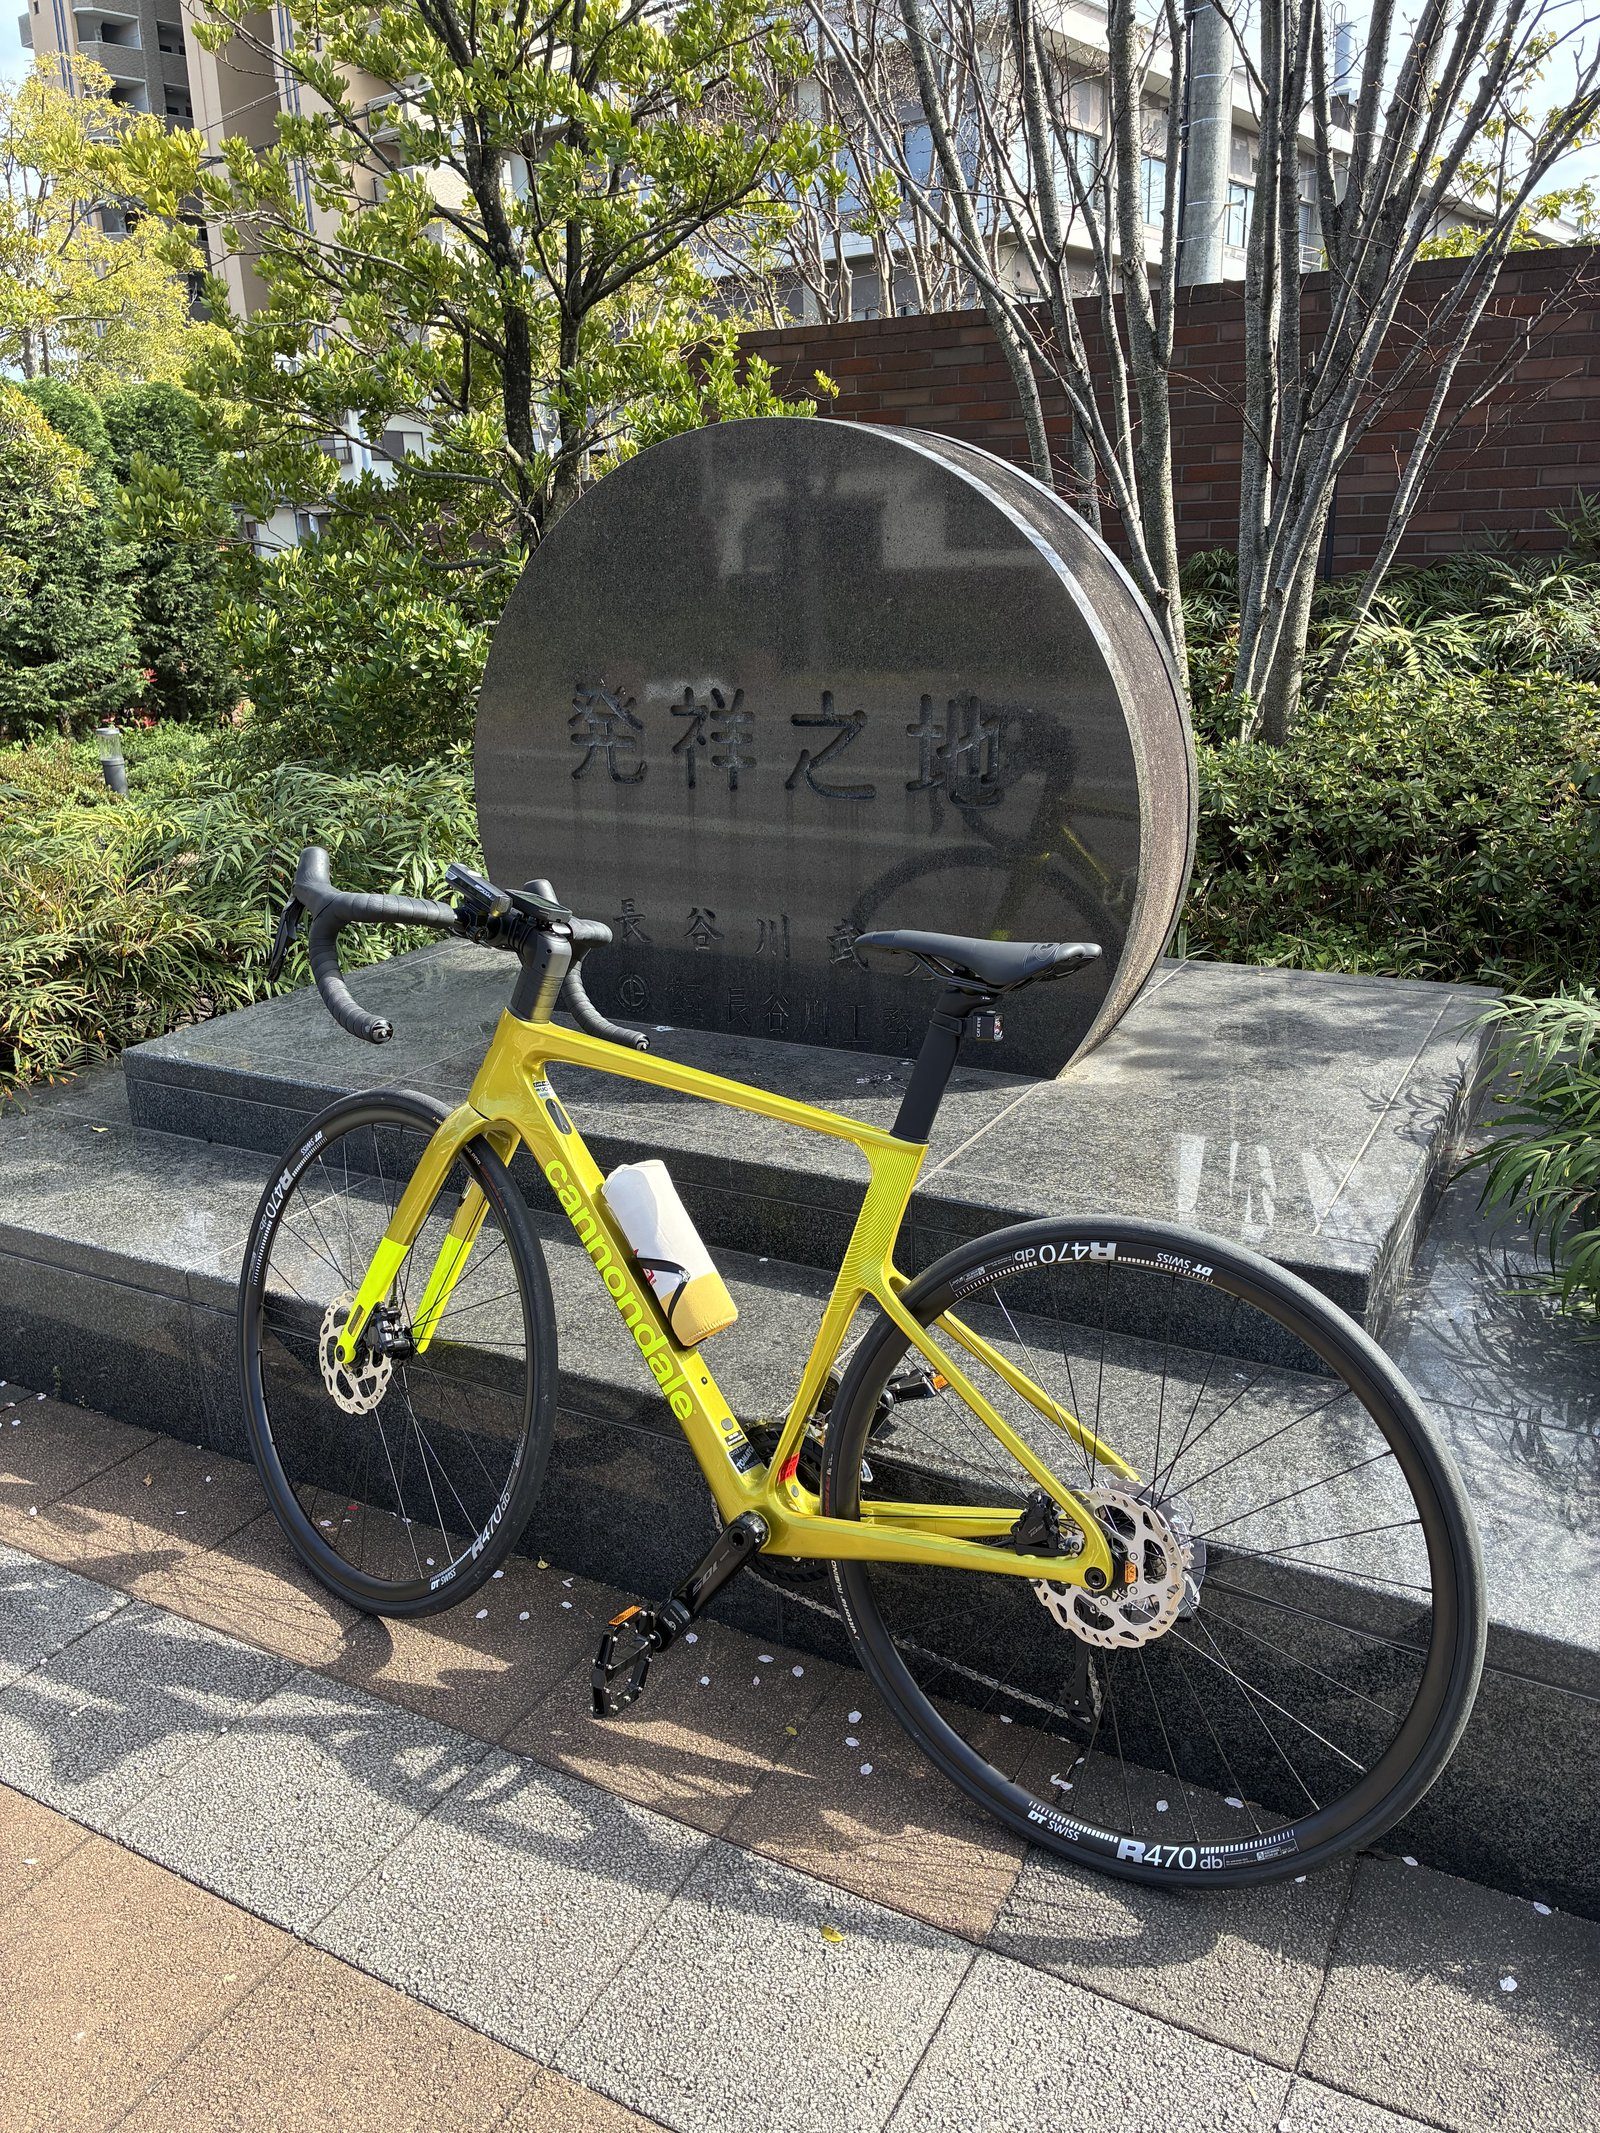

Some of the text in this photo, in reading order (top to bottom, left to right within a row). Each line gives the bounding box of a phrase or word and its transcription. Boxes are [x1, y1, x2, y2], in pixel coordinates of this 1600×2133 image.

[567, 682, 1001, 809] 発祥之地
[1014, 1242, 1117, 1264] R470 db
[1156, 1252, 1213, 1277] DT SWISS
[545, 1159, 693, 1421] cannondale
[1027, 1810, 1081, 1841] DT SWISS
[1116, 1838, 1197, 1870] R470
[1199, 1855, 1223, 1870] db
